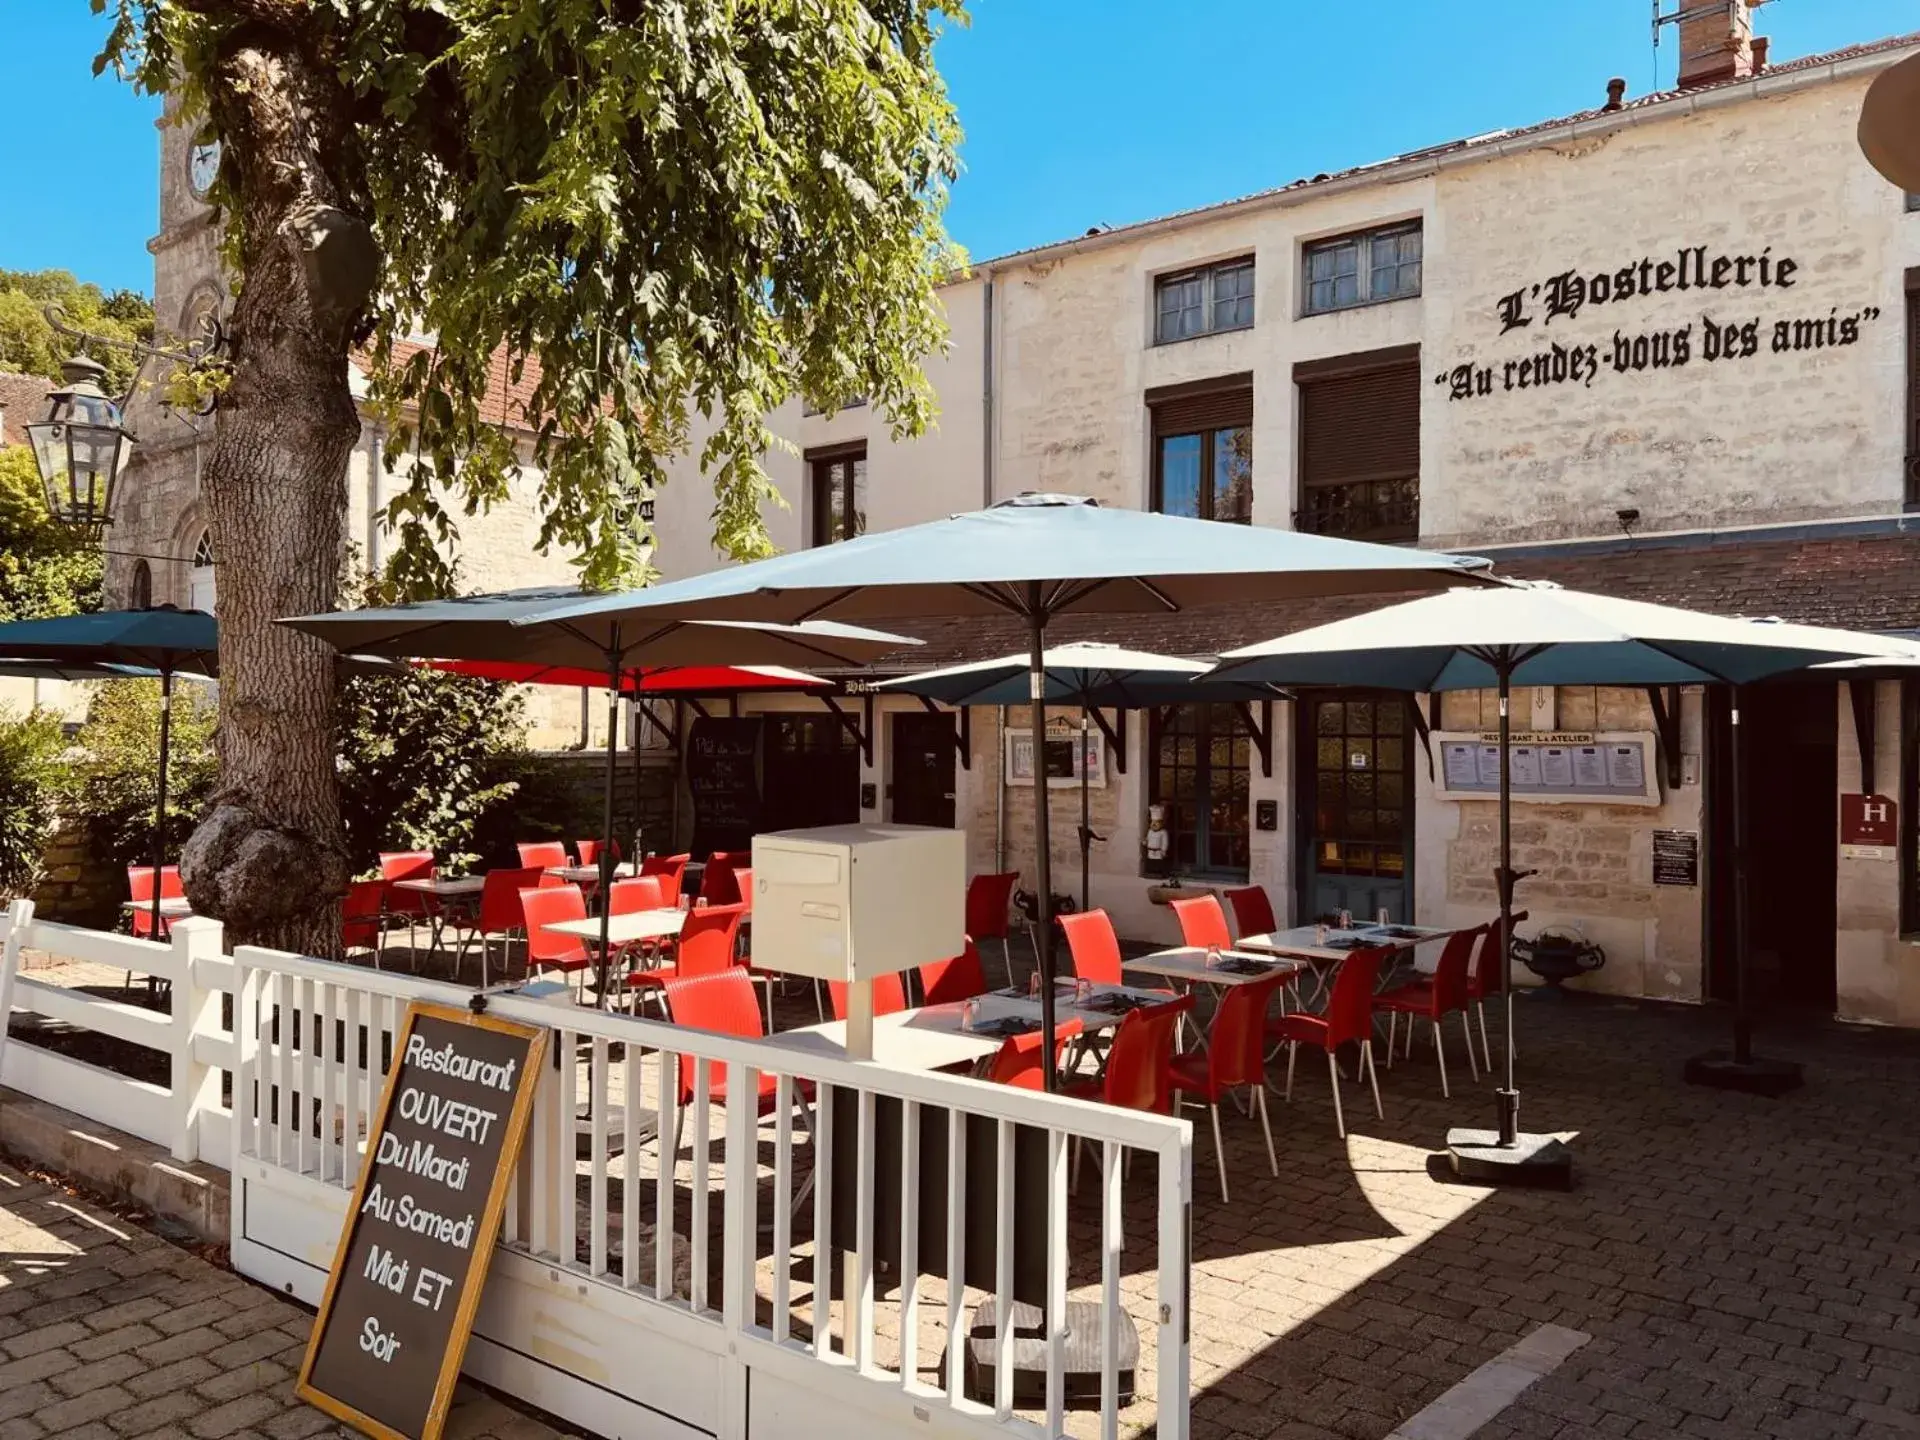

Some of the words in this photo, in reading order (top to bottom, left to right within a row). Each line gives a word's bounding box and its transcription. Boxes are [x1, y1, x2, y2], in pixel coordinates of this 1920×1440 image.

[1497, 246, 1798, 335] L'Hostellerie
[1503, 323, 1692, 391] rendez-vous
[1702, 315, 1760, 362] des
[1551, 735, 1591, 743] ATELIER
[1864, 803, 1887, 822] H
[403, 1033, 516, 1091] Restaurant
[400, 1087, 498, 1145] OUVERT
[376, 1130, 409, 1169] Du
[408, 1141, 470, 1191] Mardi
[361, 1183, 395, 1222] Au
[396, 1195, 475, 1249] Samedi
[363, 1245, 410, 1293] Midi
[412, 1268, 454, 1311] ET
[360, 1316, 401, 1363] Soir
